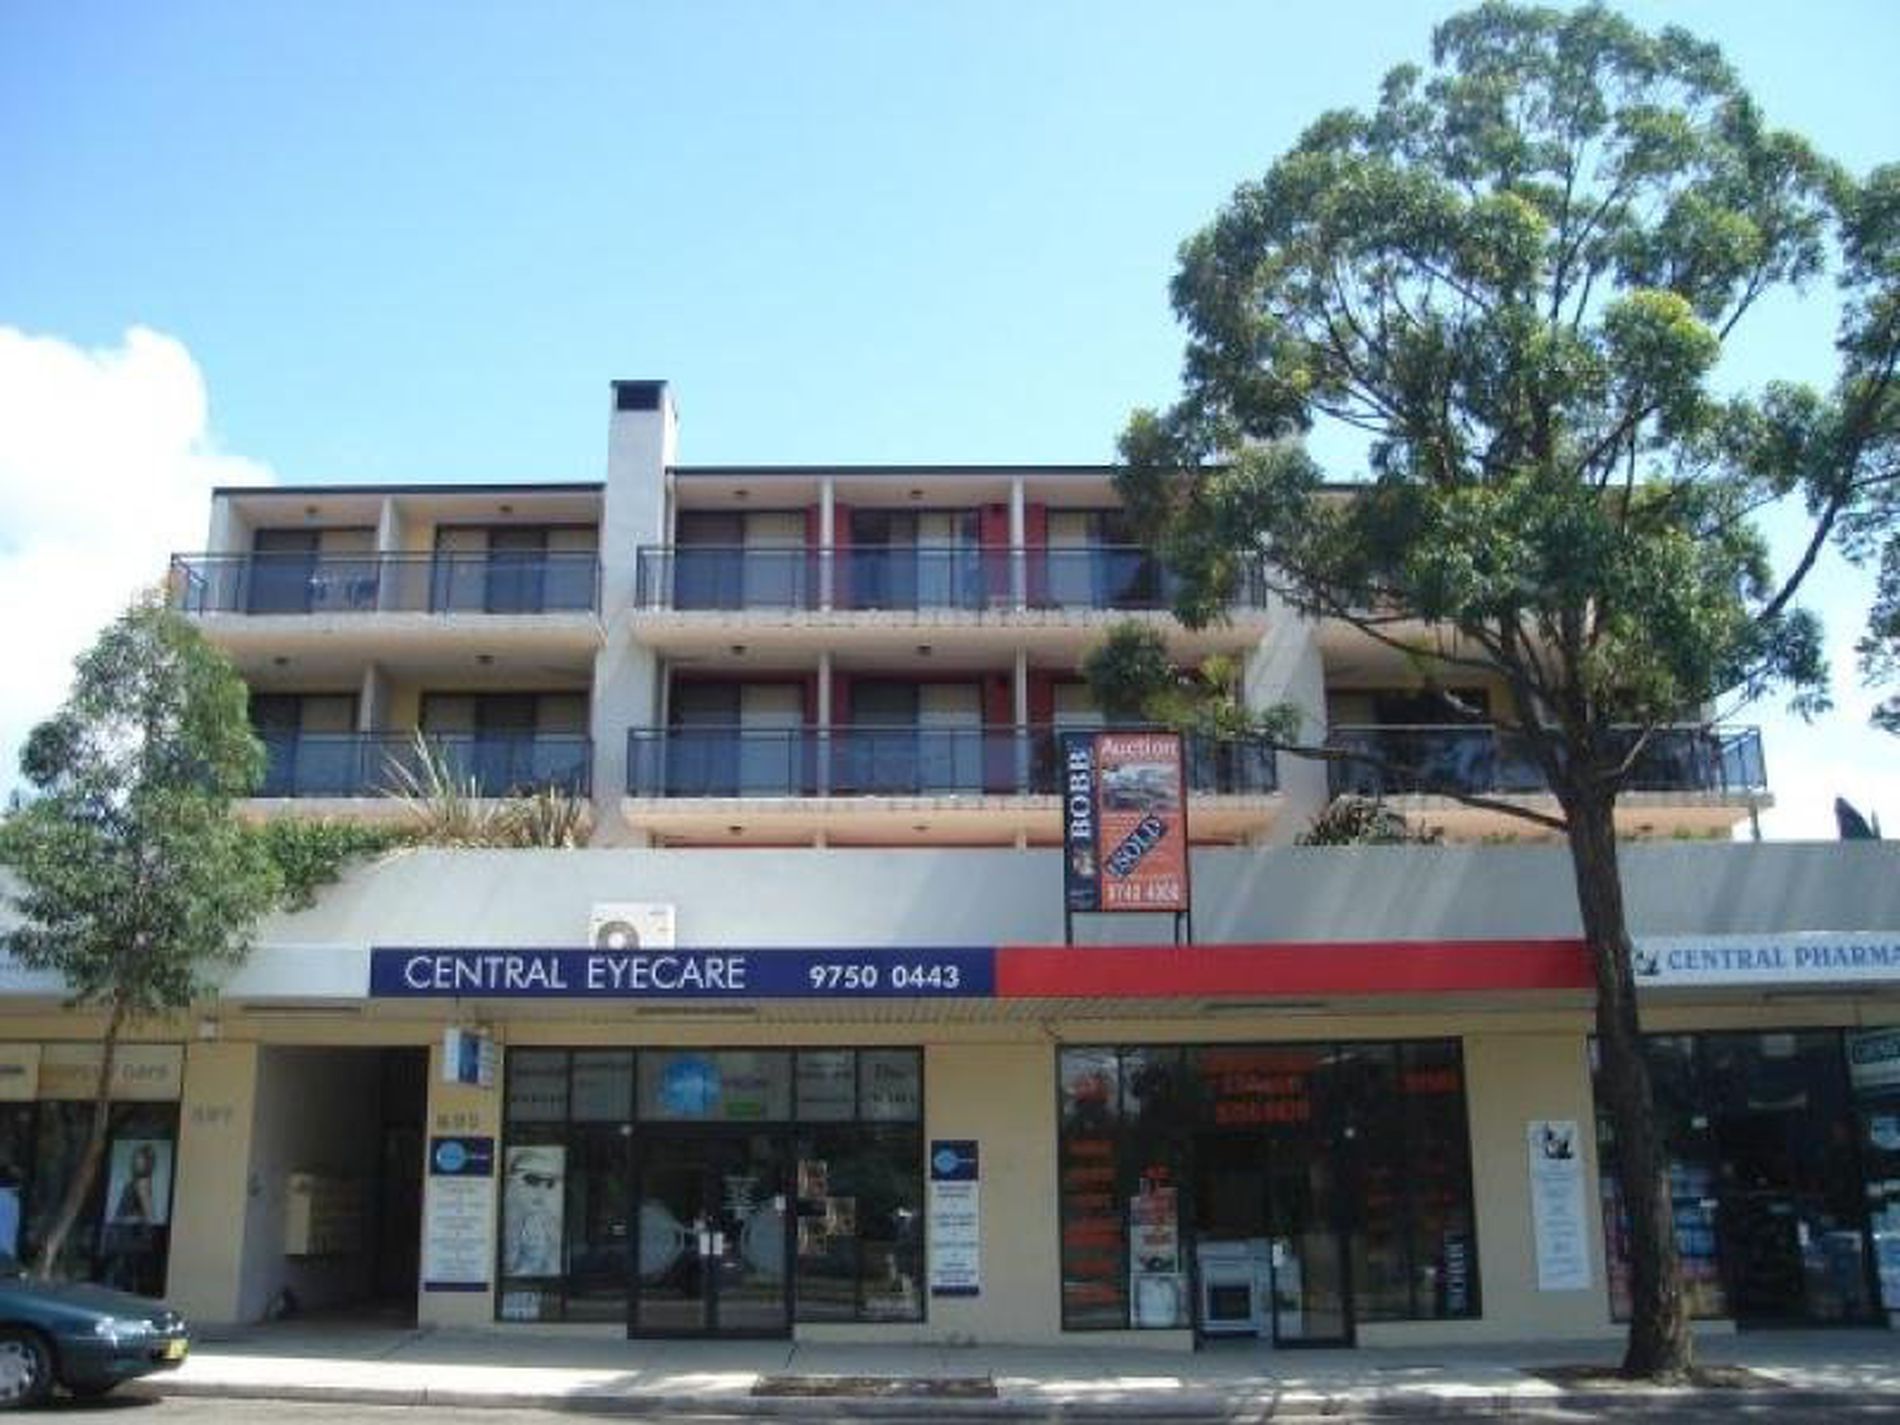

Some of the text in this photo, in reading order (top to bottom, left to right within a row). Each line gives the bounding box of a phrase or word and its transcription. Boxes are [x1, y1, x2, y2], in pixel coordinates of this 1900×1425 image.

[1101, 737, 1179, 757] Auction
[1109, 816, 1163, 878] SOLD
[1668, 947, 1786, 970] CENTRAL
[404, 955, 746, 990] CENTRAL EYECARE
[809, 964, 961, 990] 9750 0443
